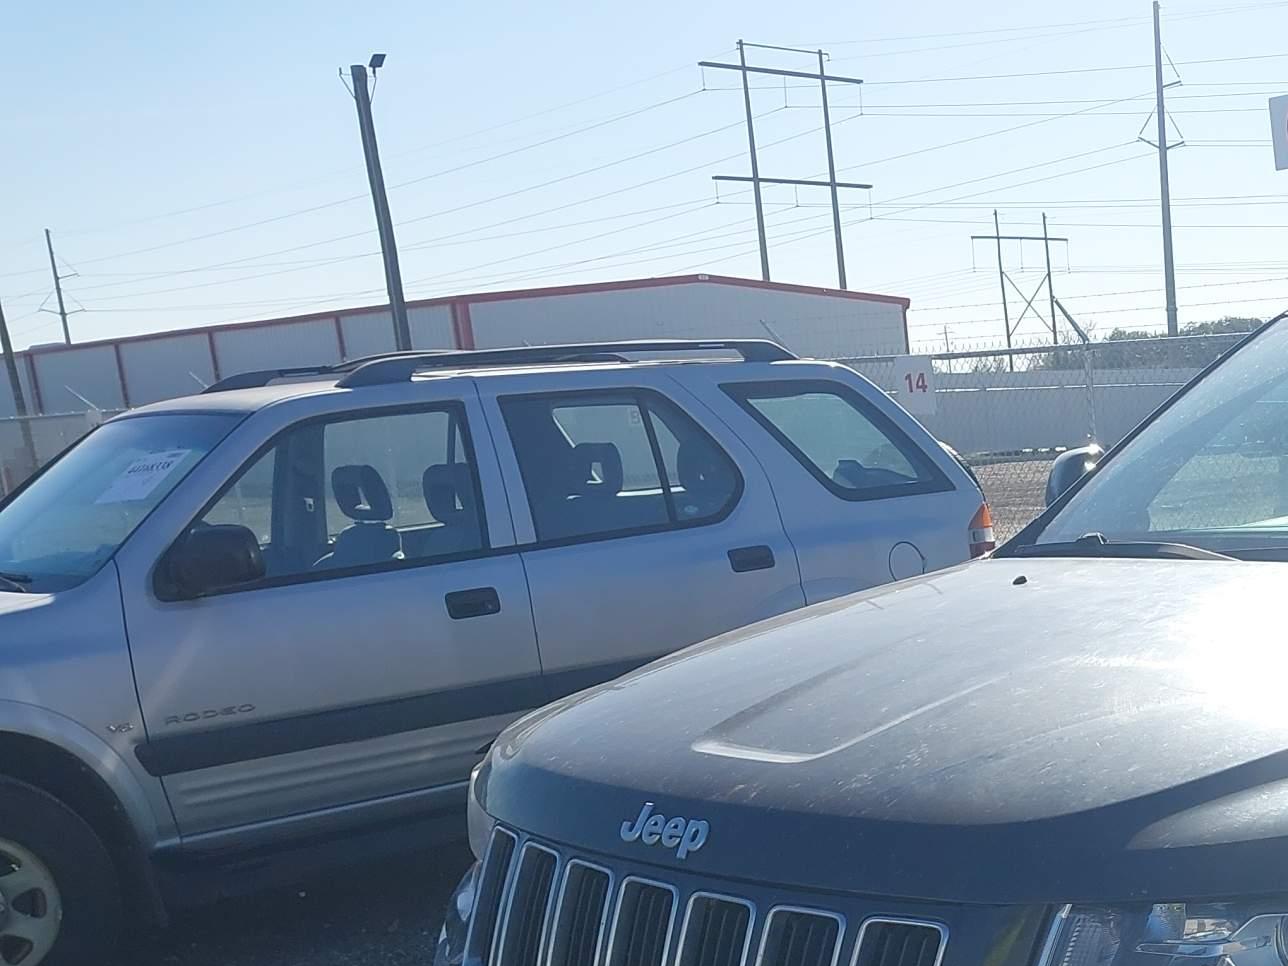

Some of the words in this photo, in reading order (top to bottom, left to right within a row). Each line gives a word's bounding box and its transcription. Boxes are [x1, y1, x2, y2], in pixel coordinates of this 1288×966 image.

[904, 372, 928, 393] 14
[165, 703, 256, 725] RODEO
[620, 801, 710, 860] Jeep
